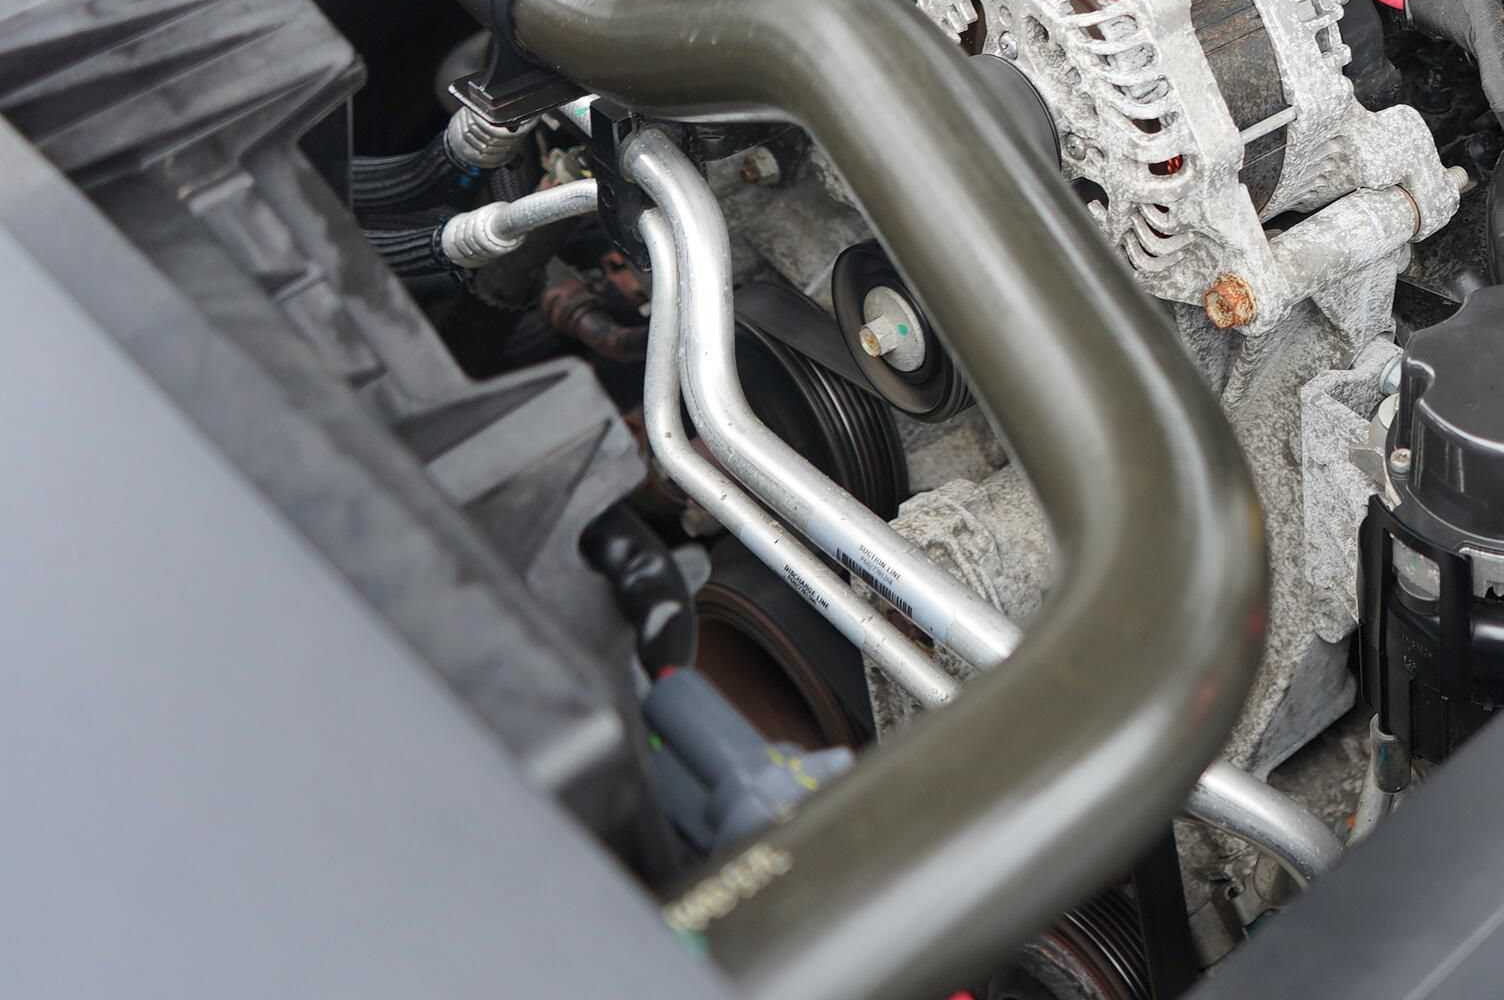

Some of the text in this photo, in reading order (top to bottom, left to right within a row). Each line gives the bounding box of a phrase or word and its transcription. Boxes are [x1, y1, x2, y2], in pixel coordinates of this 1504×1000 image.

[859, 544, 888, 569] SUCTION
[887, 566, 902, 581] LINE
[783, 564, 816, 596] DISCHARGE
[815, 594, 830, 610] LINE
